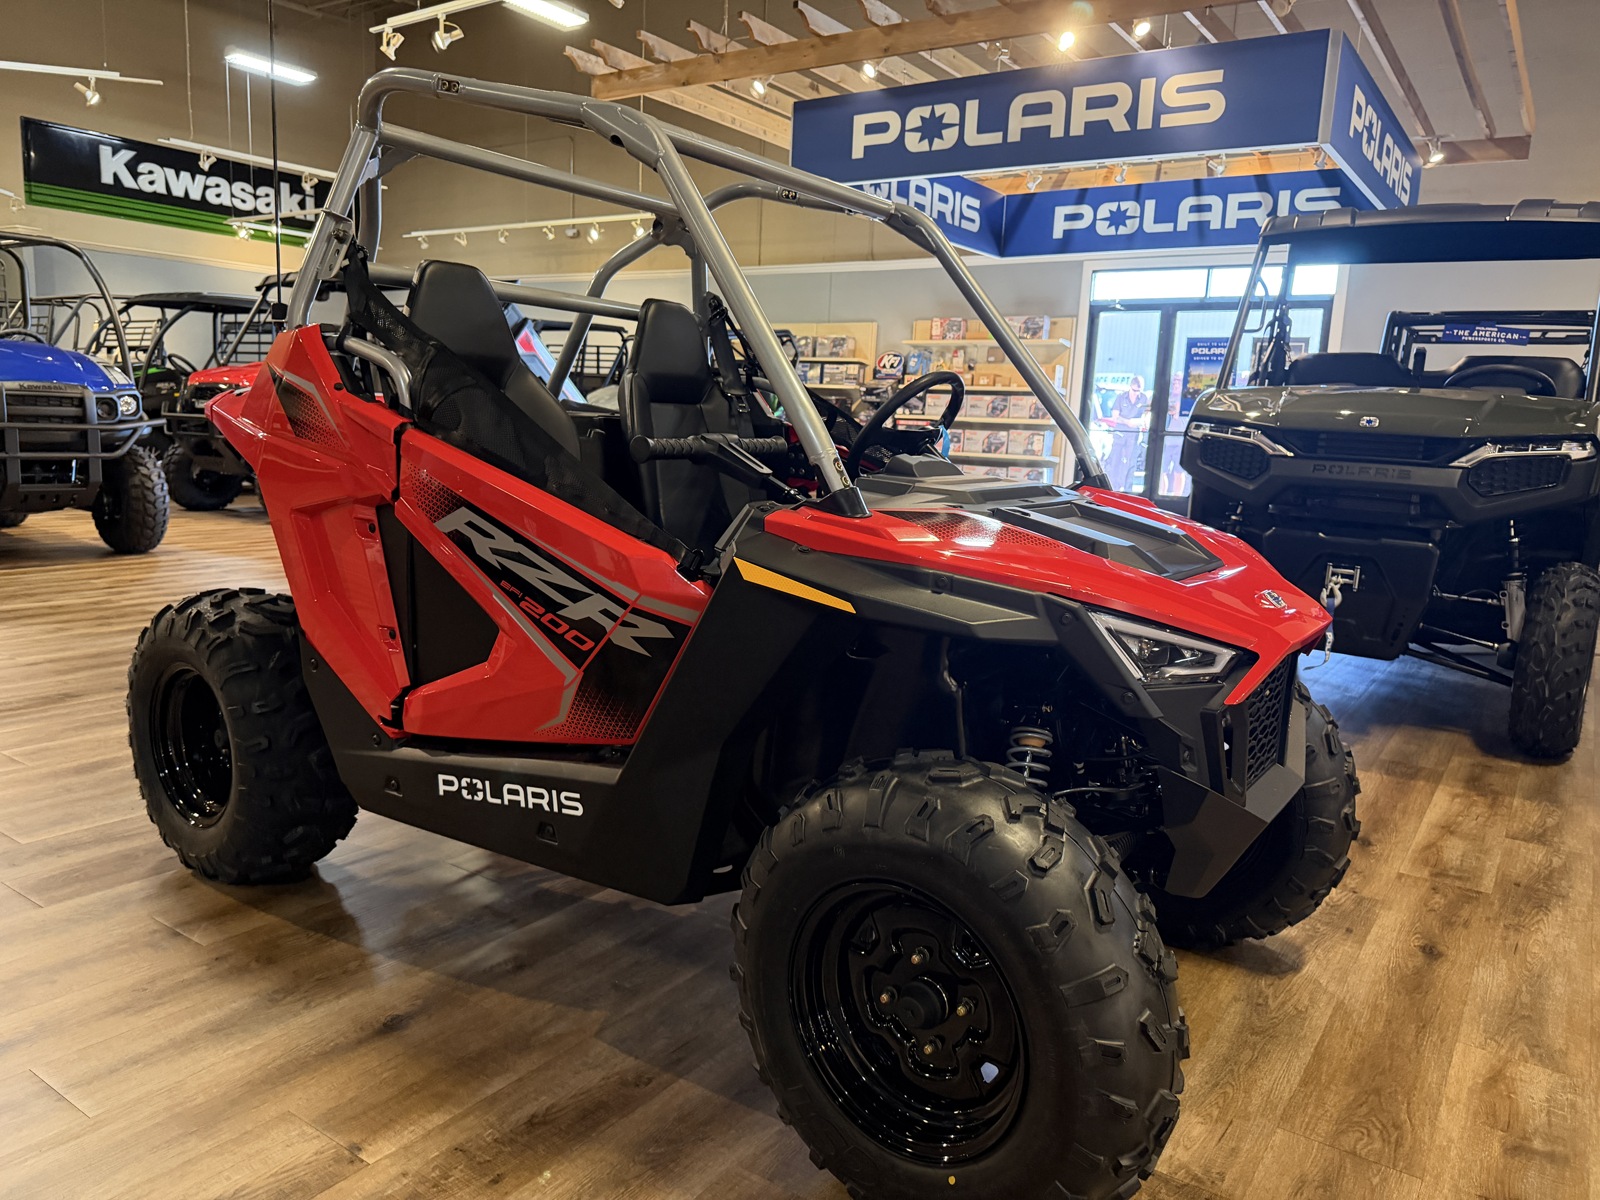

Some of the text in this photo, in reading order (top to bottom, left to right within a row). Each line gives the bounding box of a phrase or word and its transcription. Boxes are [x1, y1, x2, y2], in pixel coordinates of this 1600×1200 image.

[851, 69, 1226, 159] POLARIS
[1349, 84, 1413, 206] POLARIS
[98, 144, 316, 221] Kawasaki
[1052, 187, 1342, 239] POLARIS
[1472, 330, 1519, 340] AMERICAN
[18, 383, 67, 391] Kawasaki
[879, 354, 901, 369] KFI
[1311, 463, 1412, 479] POLARIS
[434, 507, 675, 657] RZR
[500, 580, 595, 651] EFI 200
[437, 774, 584, 817] POLARIS
